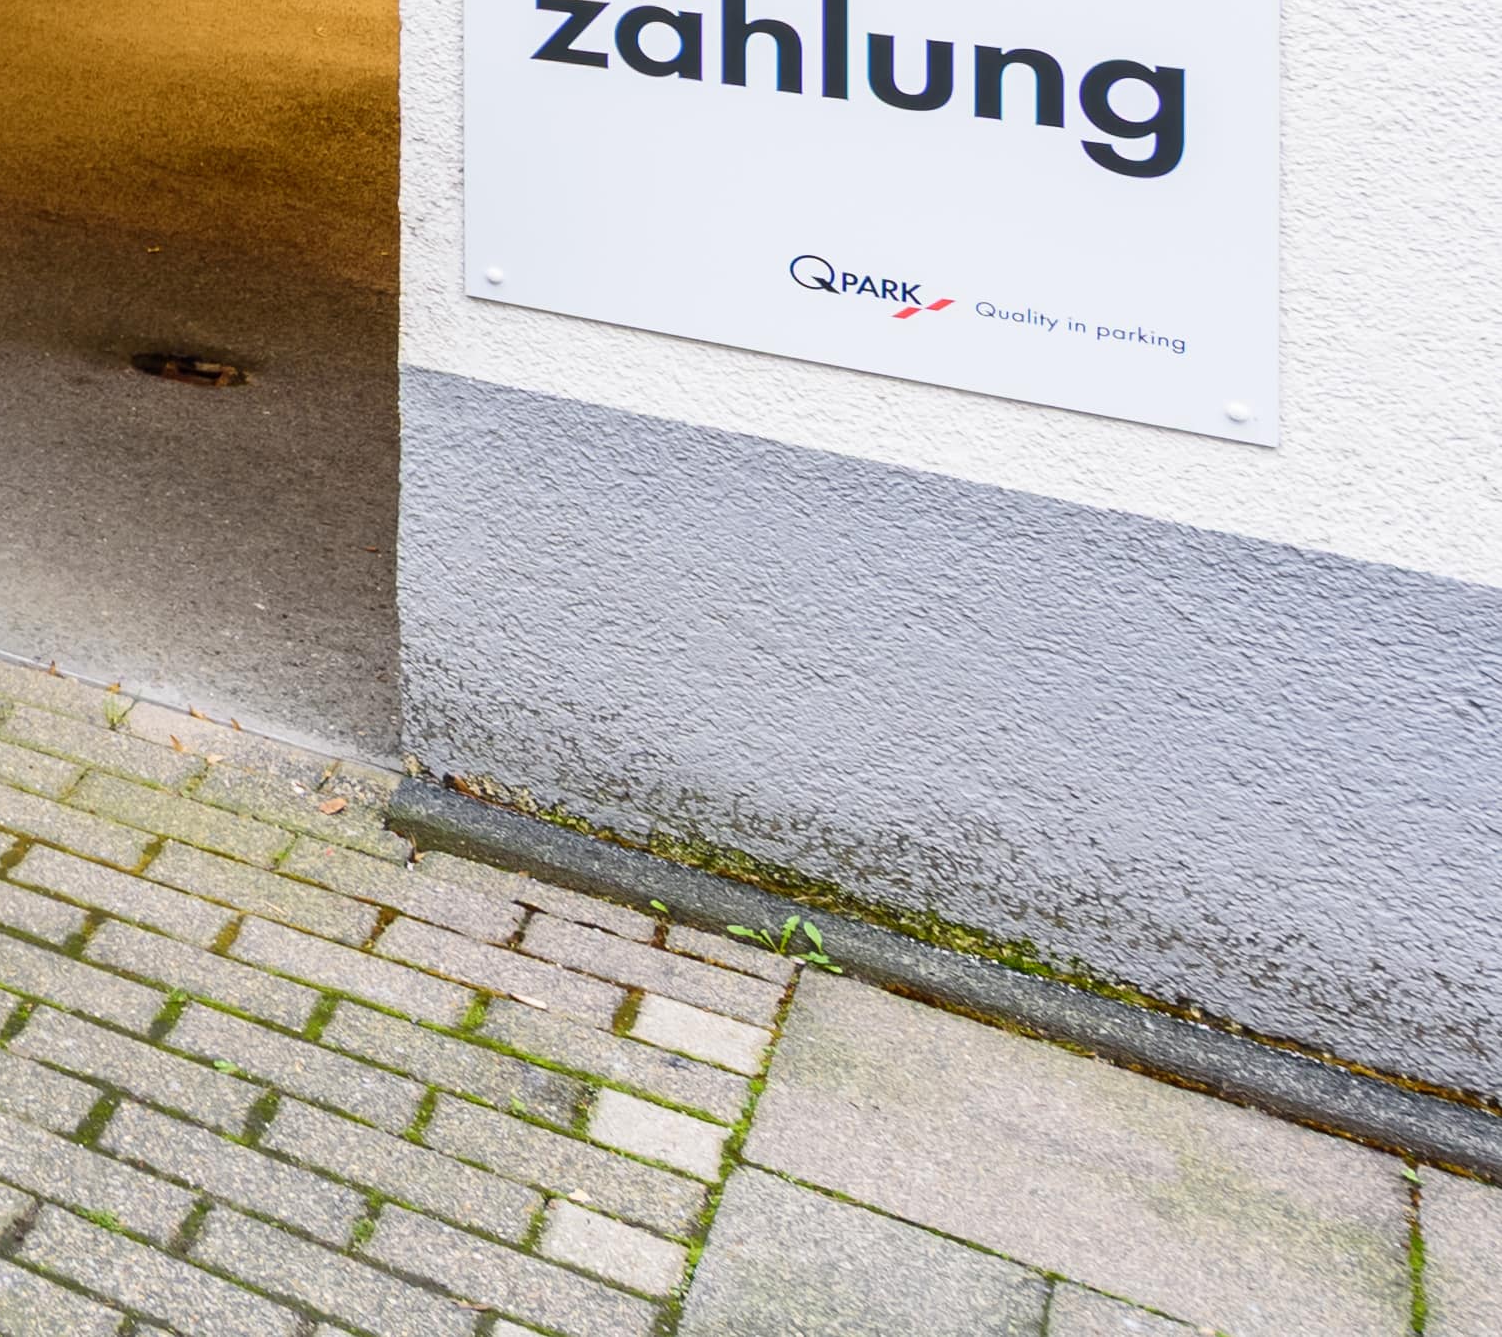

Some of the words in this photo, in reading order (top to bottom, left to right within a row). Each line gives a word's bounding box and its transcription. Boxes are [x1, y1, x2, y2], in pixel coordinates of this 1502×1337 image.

[975, 301, 1058, 332] Quality
[1068, 317, 1086, 333] in
[1096, 322, 1186, 355] parking
